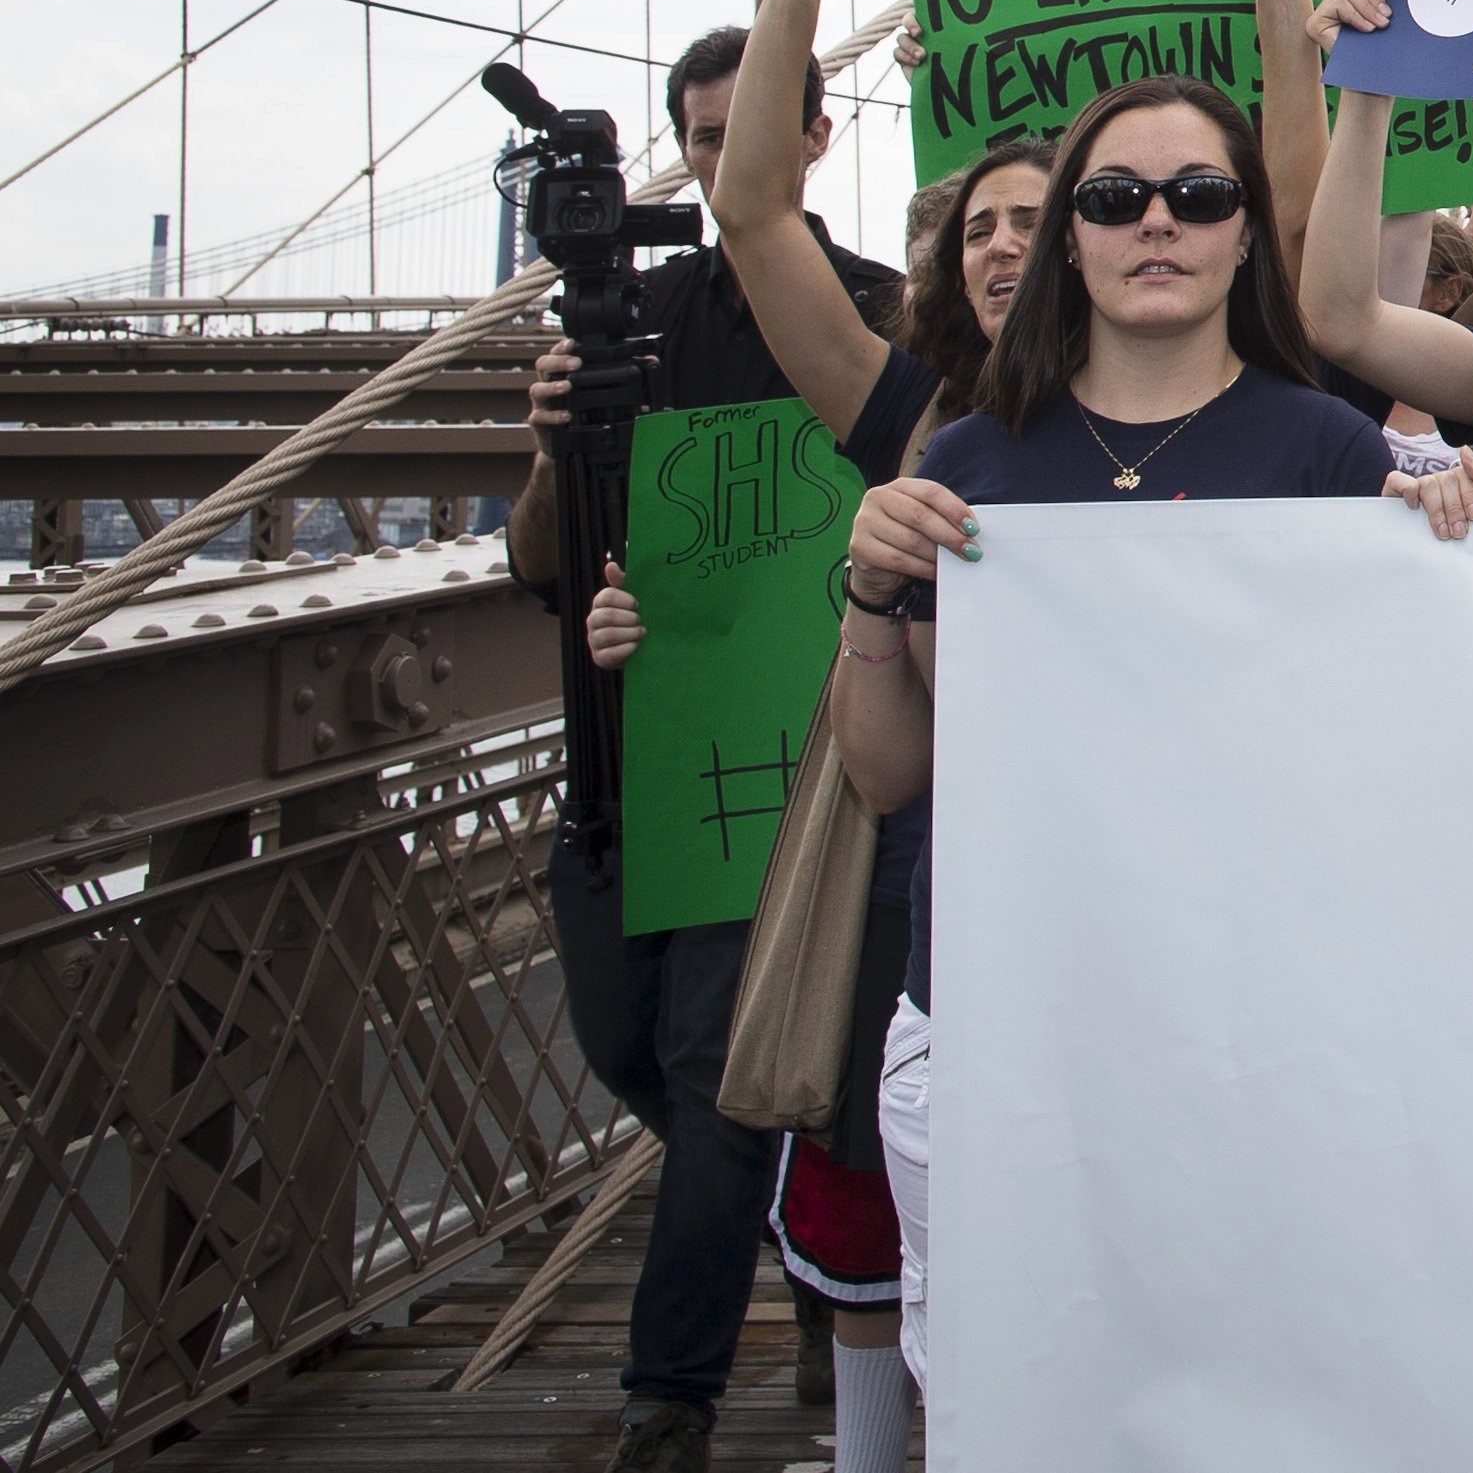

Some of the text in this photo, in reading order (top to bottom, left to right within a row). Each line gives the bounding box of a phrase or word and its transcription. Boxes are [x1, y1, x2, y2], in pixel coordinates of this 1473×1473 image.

[688, 405, 760, 433] Former
[657, 416, 842, 566] SHS
[698, 535, 792, 580] STUDENT
